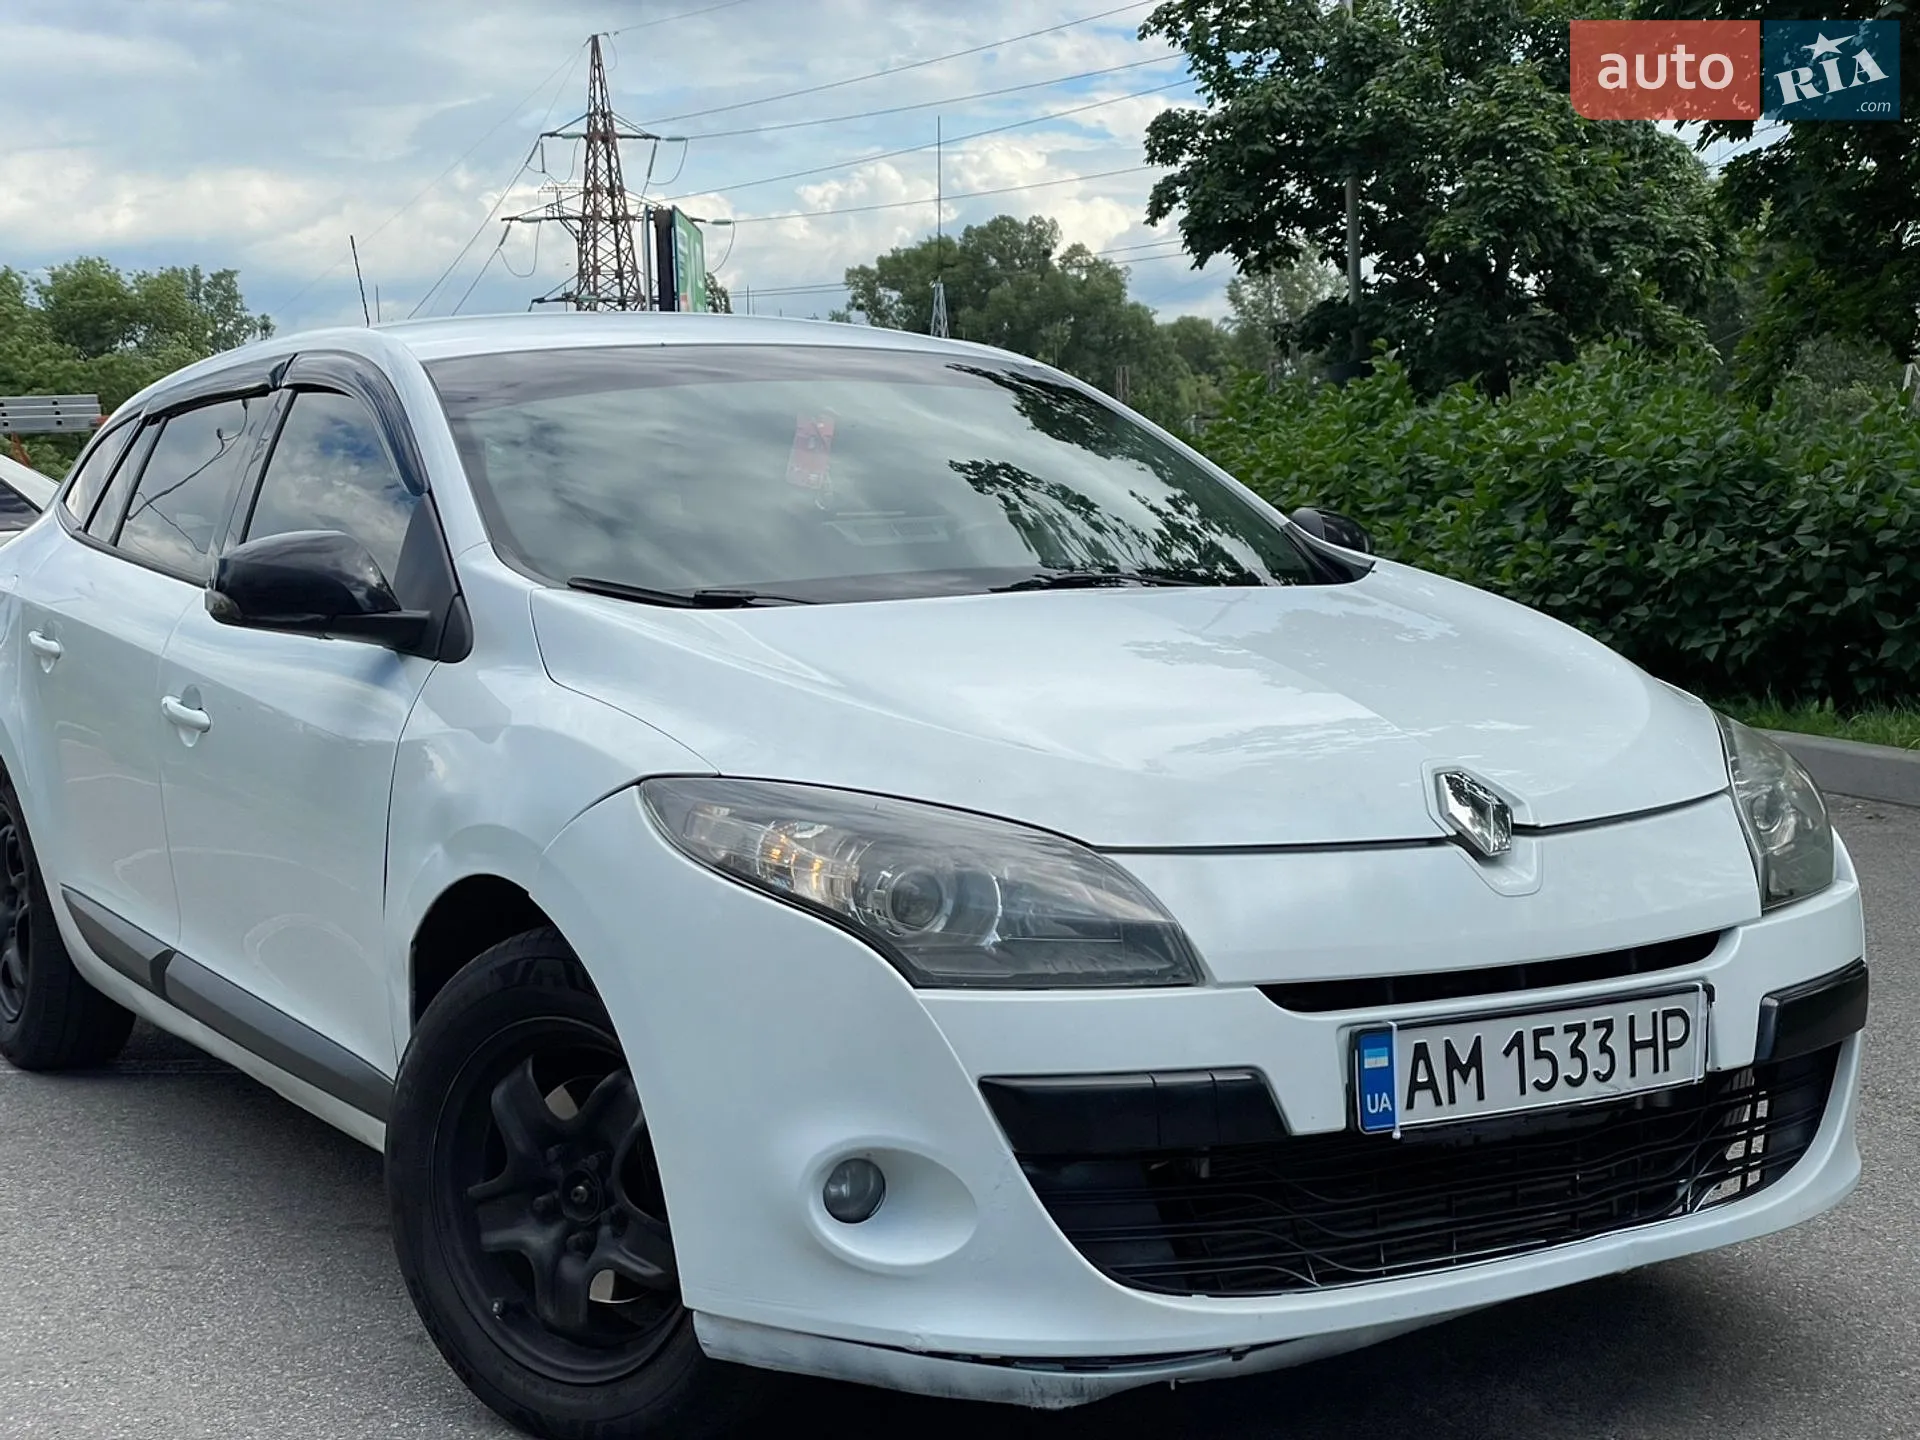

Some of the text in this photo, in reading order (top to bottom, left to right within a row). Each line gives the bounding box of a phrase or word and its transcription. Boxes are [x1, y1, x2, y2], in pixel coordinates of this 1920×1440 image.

[1405, 1007, 1692, 1111] AM 1533 HP
[1366, 1092, 1393, 1114] UA
